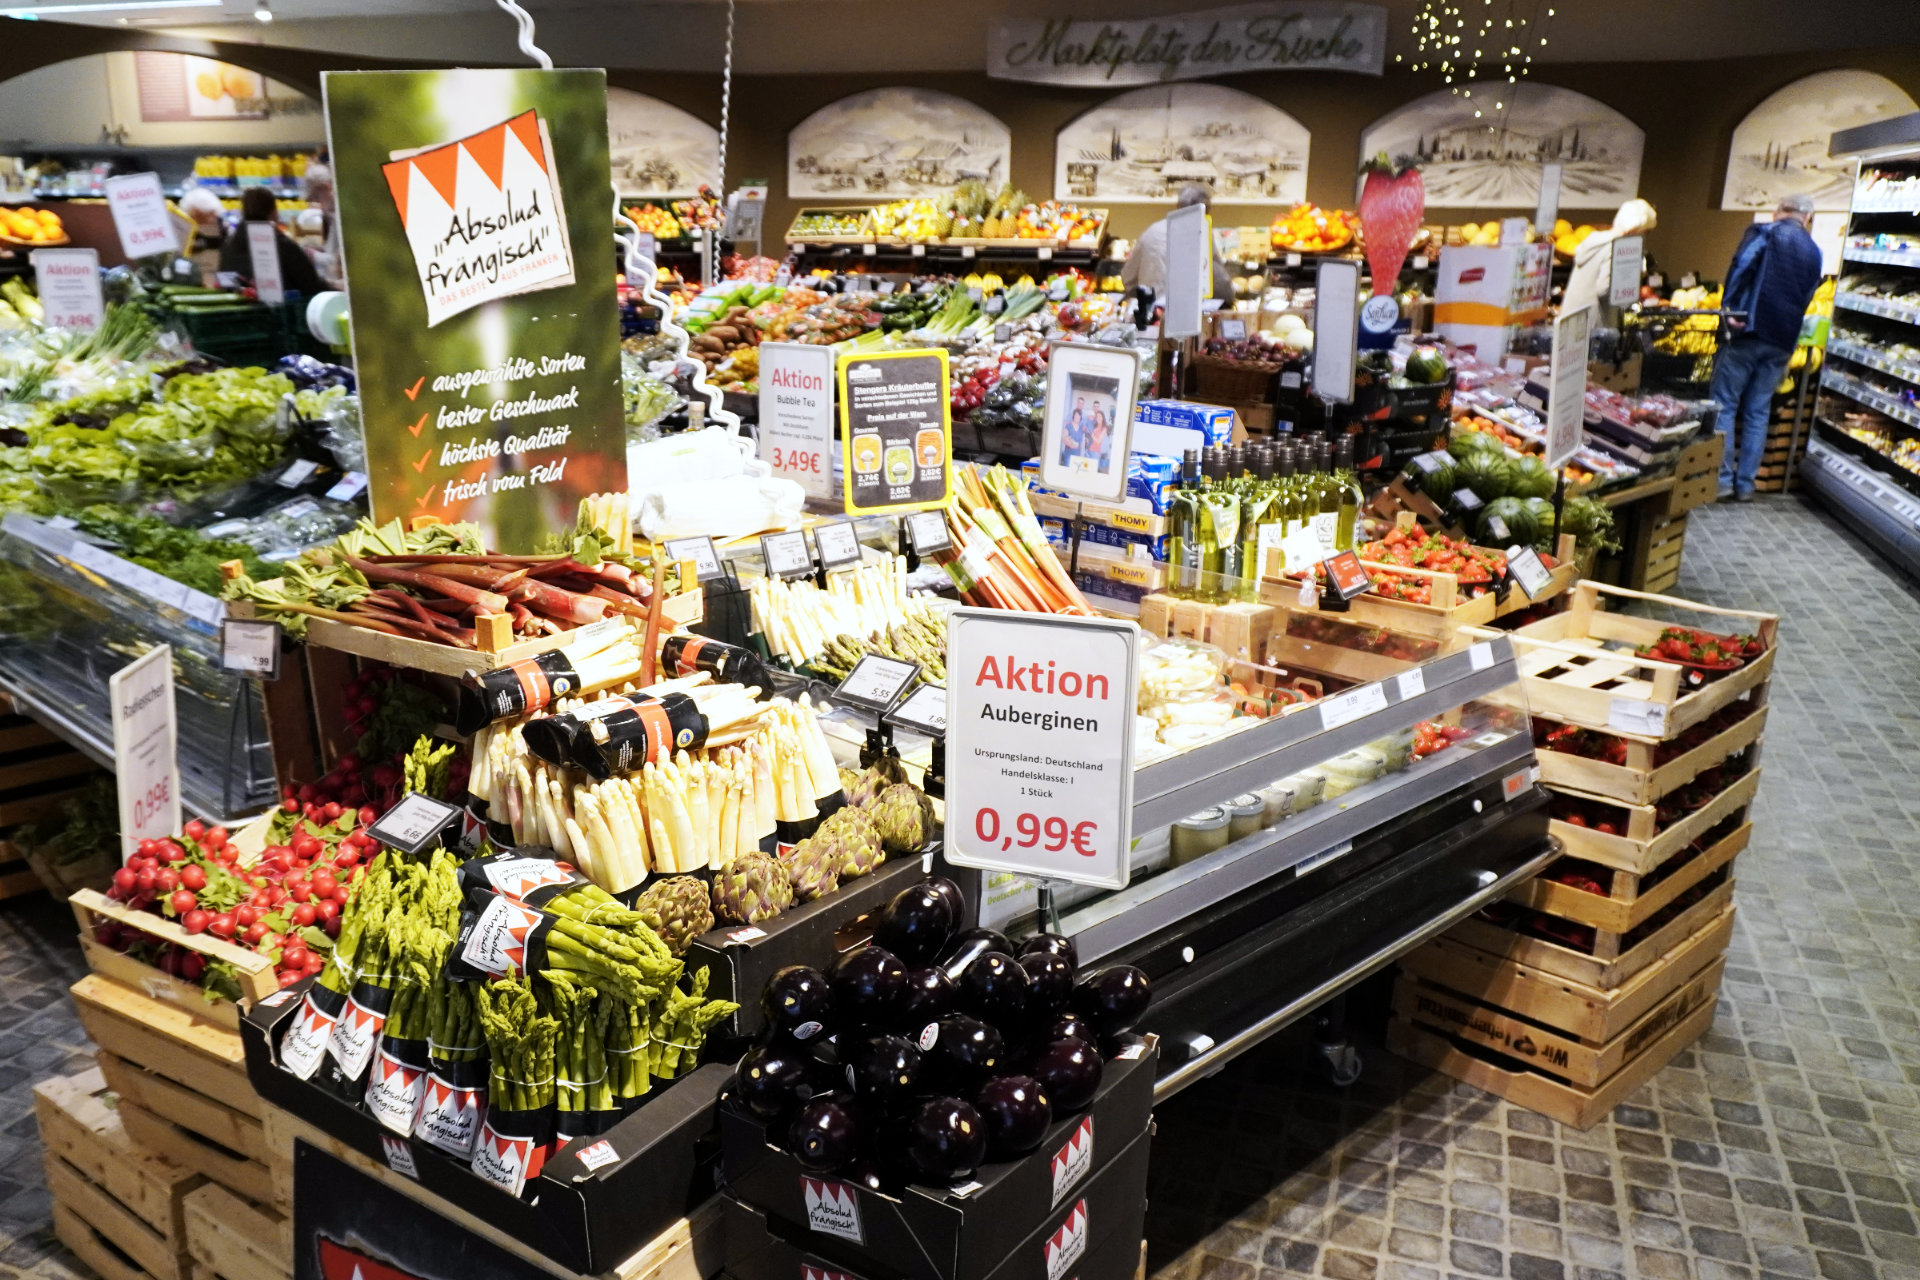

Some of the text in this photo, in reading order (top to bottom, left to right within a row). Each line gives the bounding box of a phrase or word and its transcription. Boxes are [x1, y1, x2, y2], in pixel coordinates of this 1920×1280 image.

[1006, 13, 1363, 81] Marktplatz der Frische
[440, 254, 559, 307] DAS BESTE AUS FRANKEN
[432, 352, 586, 398] ausgewählte Sorten
[771, 368, 822, 391] Aktion
[888, 381, 937, 392] Kräuterbutter
[436, 386, 579, 429] bester Geschmack
[777, 394, 816, 408] Bubble Tea
[867, 413, 885, 422] Preis
[886, 411, 897, 421] auf
[440, 425, 571, 467] höchste Qualität
[773, 447, 821, 474] 3,49€
[443, 457, 567, 507] frisch vom Feld
[1114, 514, 1148, 527] THOMY
[1111, 565, 1145, 579] THOMY
[976, 655, 1109, 700] Aktion
[872, 687, 890, 699] 5,55
[980, 703, 1098, 732] Auberginen
[974, 748, 1103, 772] Ursprungsland: Deutschland
[1001, 768, 1068, 785] Handelsklasse:
[134, 776, 169, 829] 0,99€
[1028, 787, 1053, 799] Stück
[975, 806, 1098, 857] 0,99€
[1541, 1043, 1570, 1069] Wir
